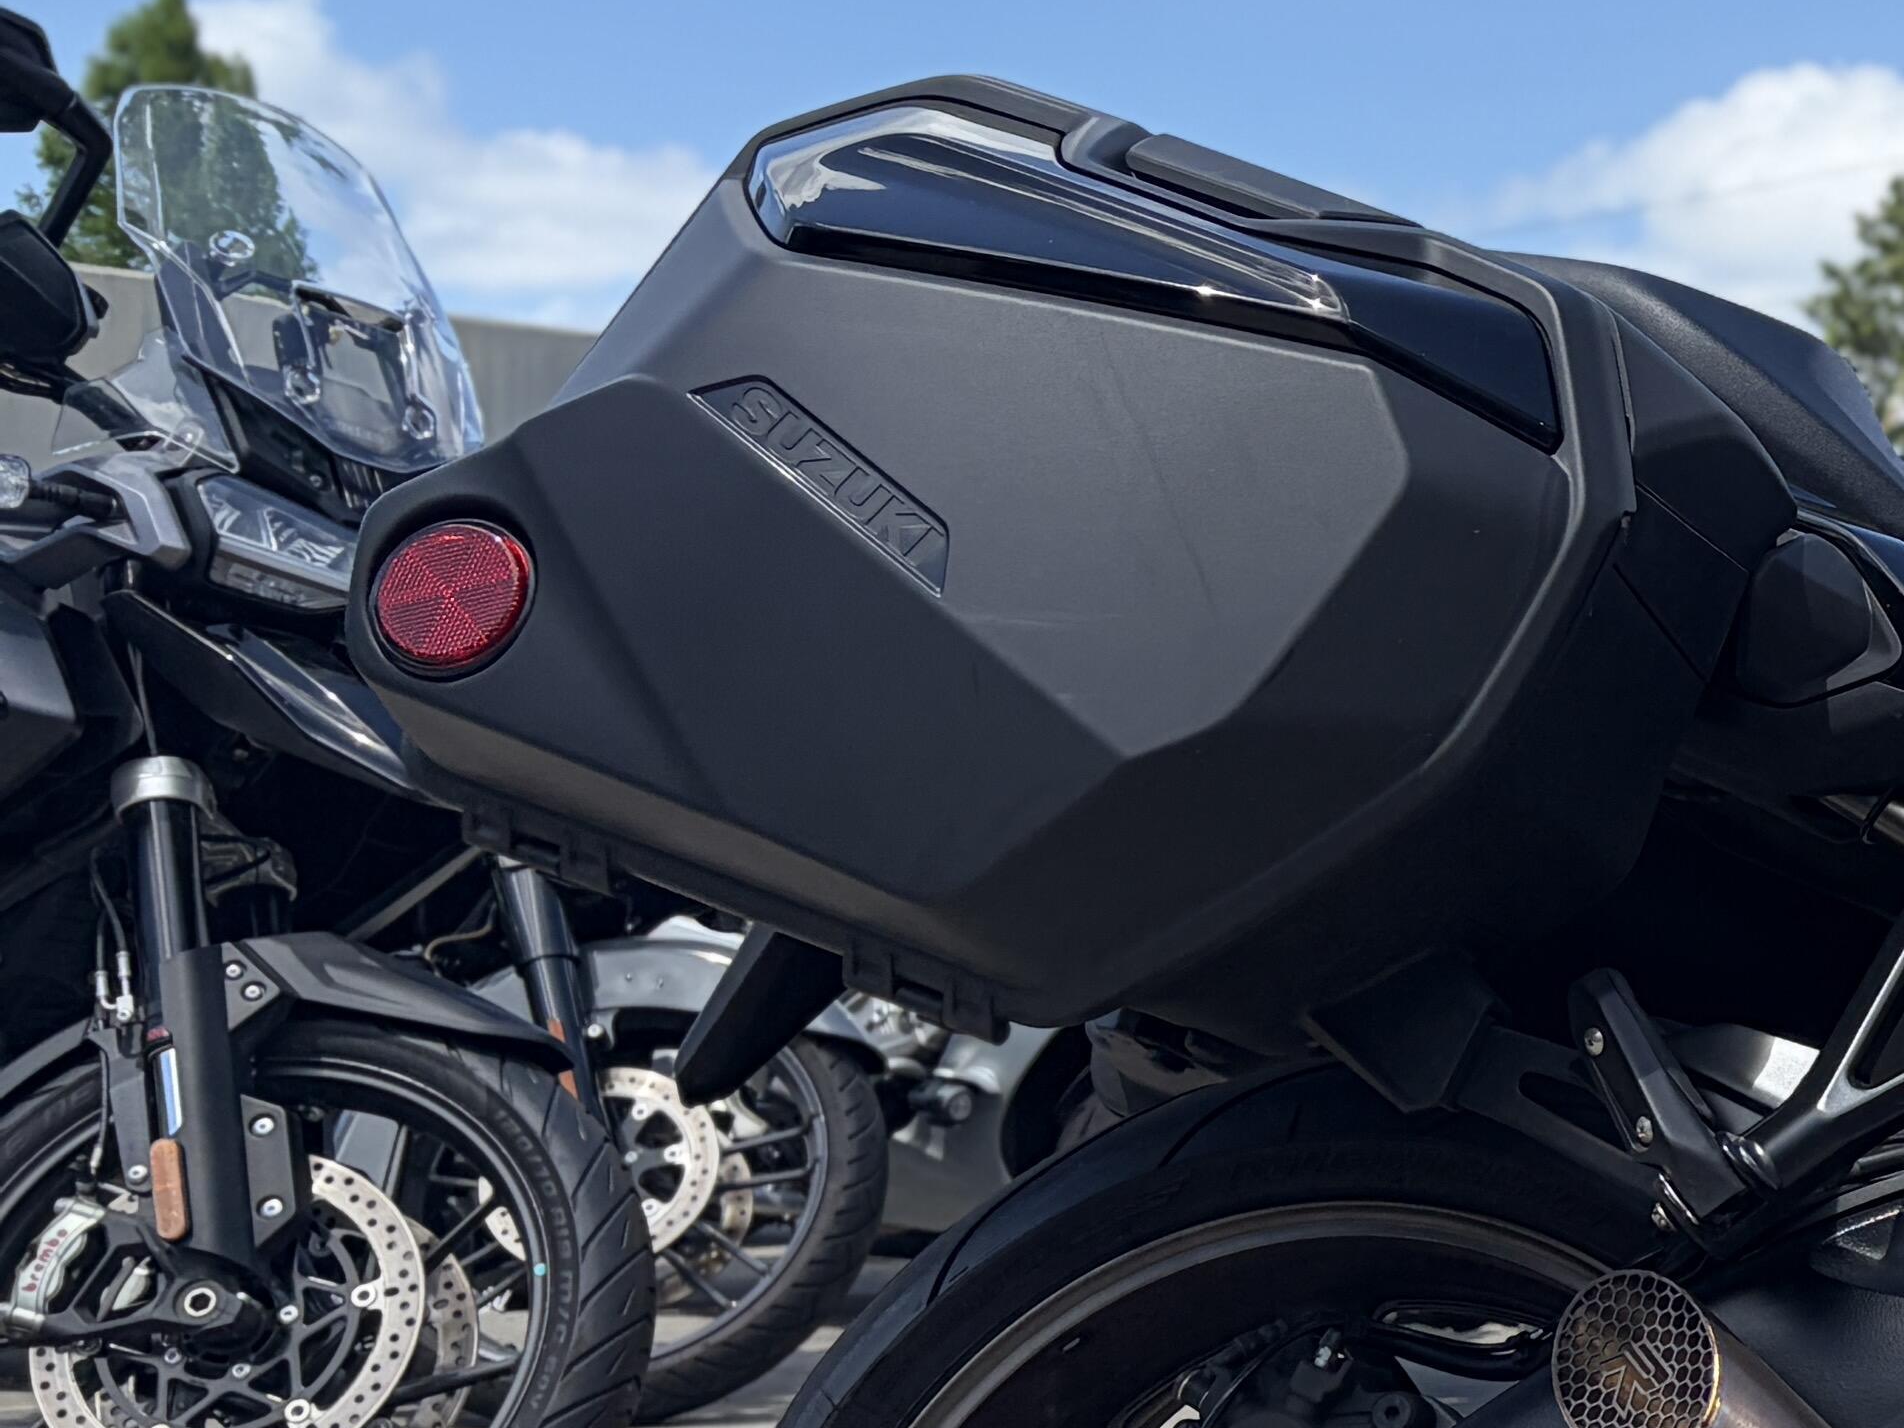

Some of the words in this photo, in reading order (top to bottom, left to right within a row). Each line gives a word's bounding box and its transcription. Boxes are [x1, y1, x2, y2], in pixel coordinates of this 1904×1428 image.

[732, 386, 945, 566] SUZUKI
[20, 1228, 69, 1293] brembo
[554, 1270, 574, 1345] M/C
